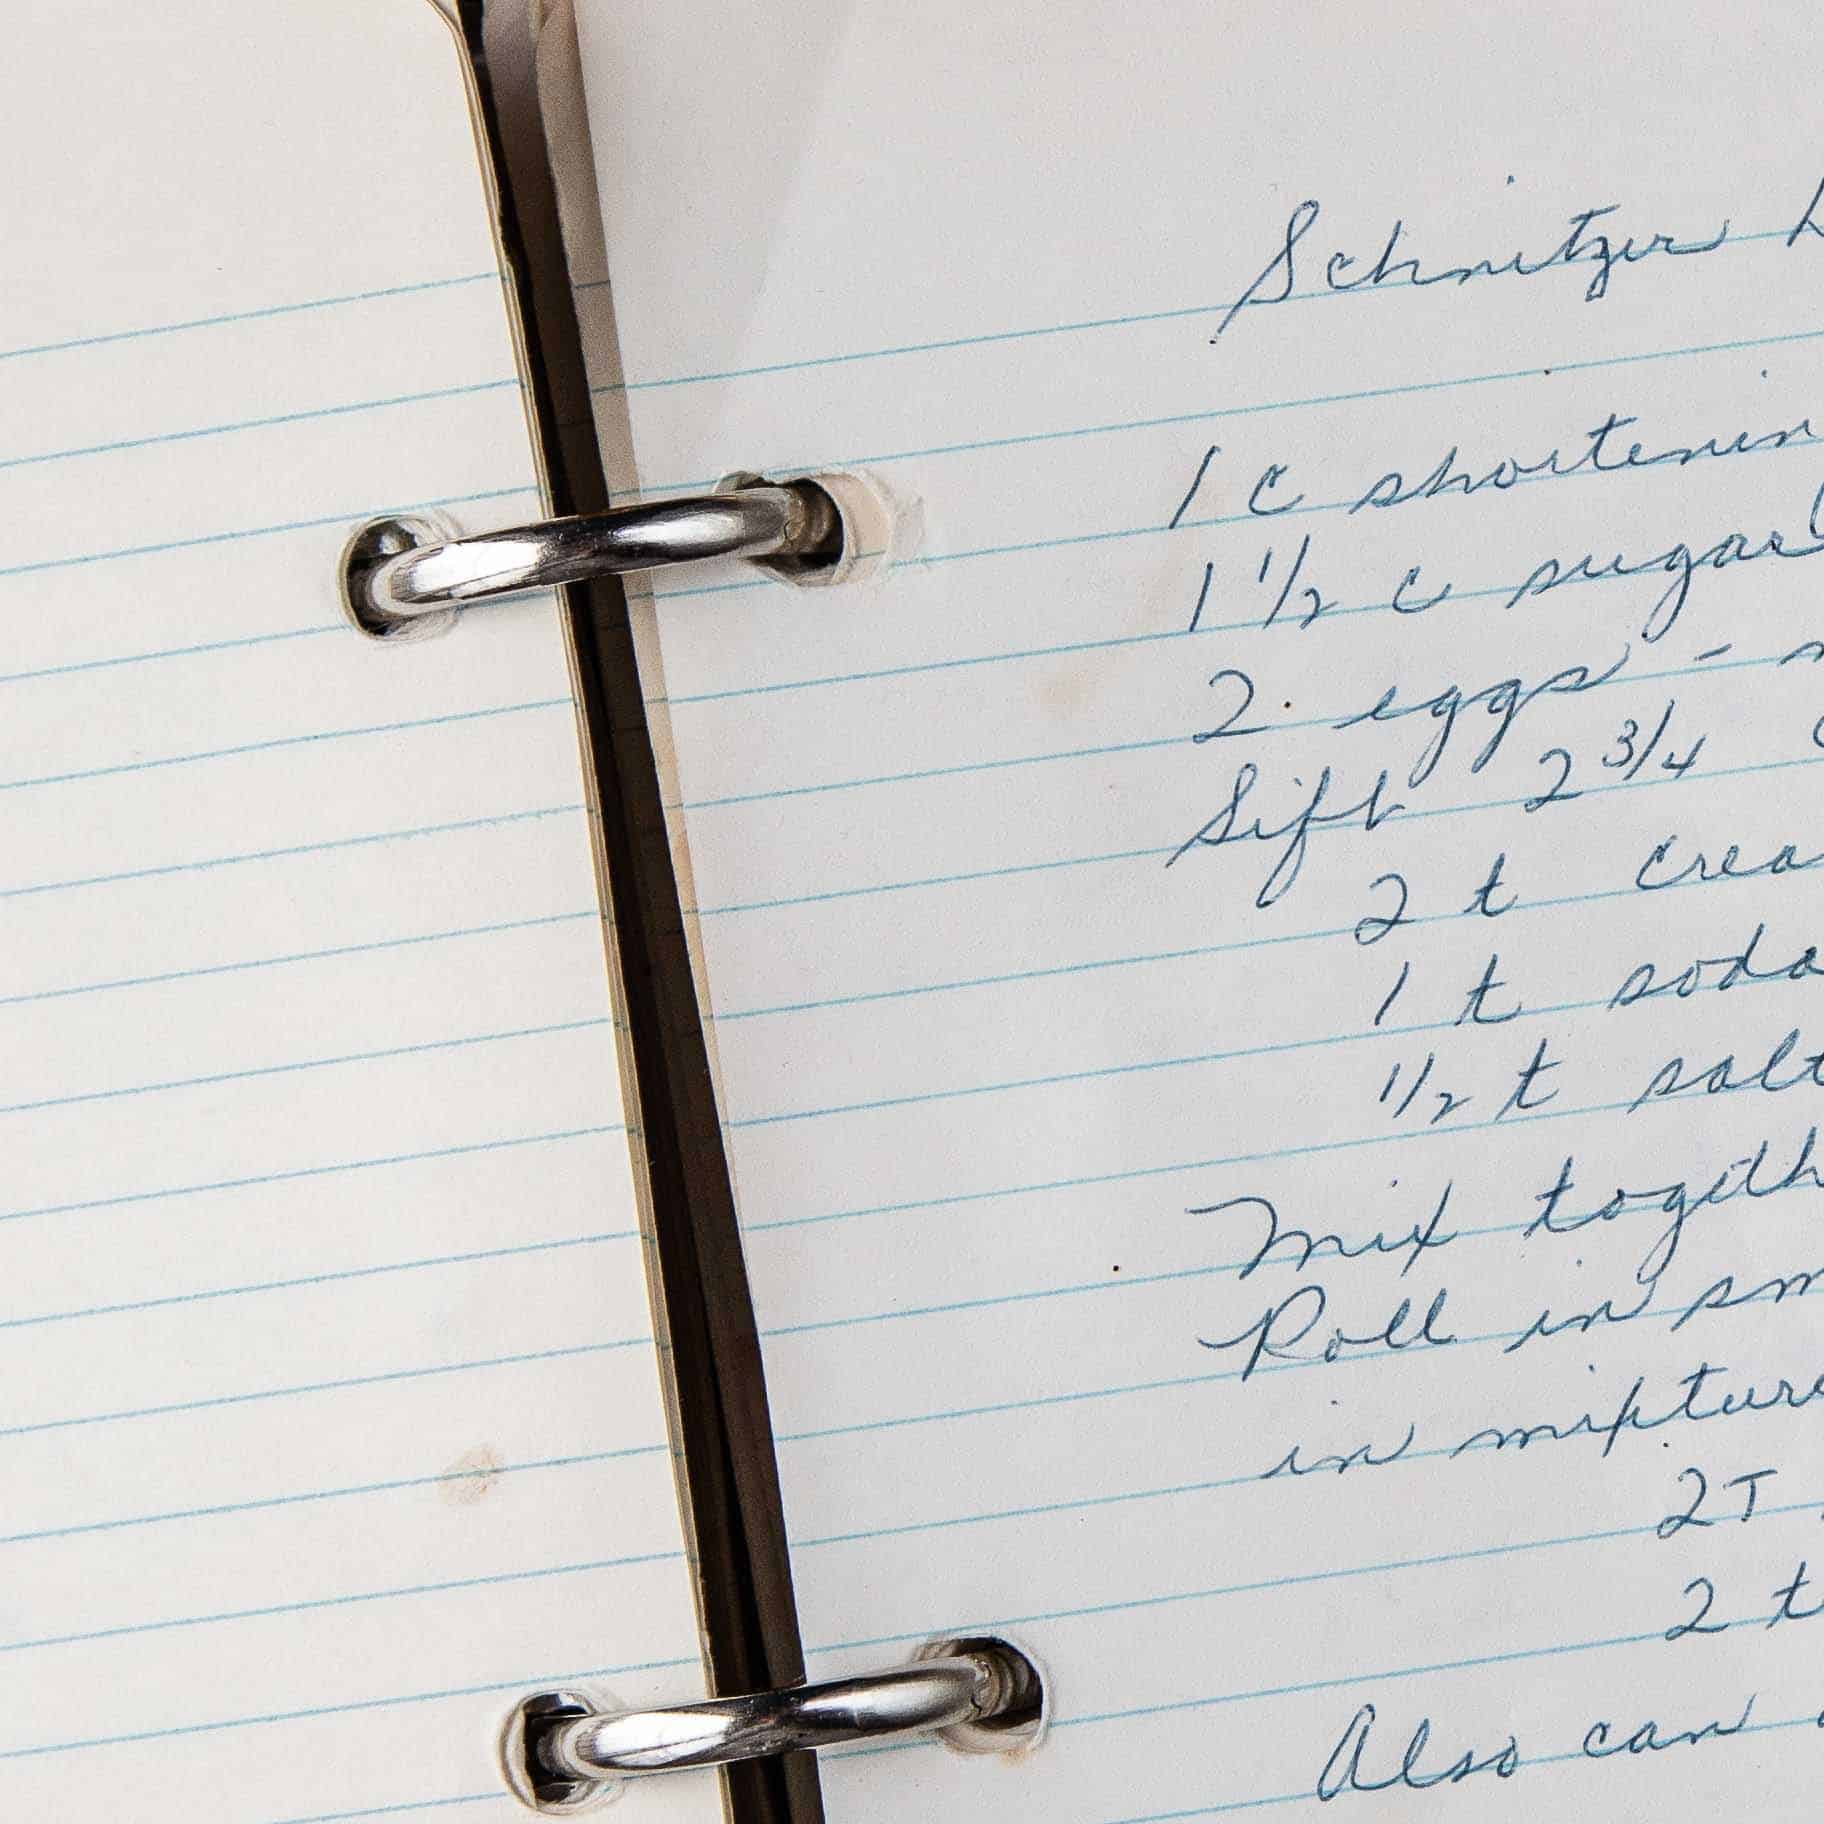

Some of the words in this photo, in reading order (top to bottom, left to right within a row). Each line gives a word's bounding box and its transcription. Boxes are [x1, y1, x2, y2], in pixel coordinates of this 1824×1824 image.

[1169, 445, 1221, 530] 1
[1331, 643, 1631, 789] eggs
[1166, 762, 1405, 908] Sift
[1355, 873, 1414, 945] 2
[1464, 853, 1518, 917] t
[1374, 961, 1409, 1025] 1
[1454, 953, 1522, 1026] t
[1379, 1052, 1473, 1124] 1/2
[1495, 1038, 1562, 1120] t
[1184, 1179, 1460, 1280] Mix
[1198, 1286, 1458, 1382] Roll
[1503, 1259, 1655, 1354] in
[1258, 1400, 1414, 1479] in
[1664, 1577, 1729, 1641] 2
[1317, 1704, 1520, 1802] Also
[1582, 1692, 1757, 1758] can
